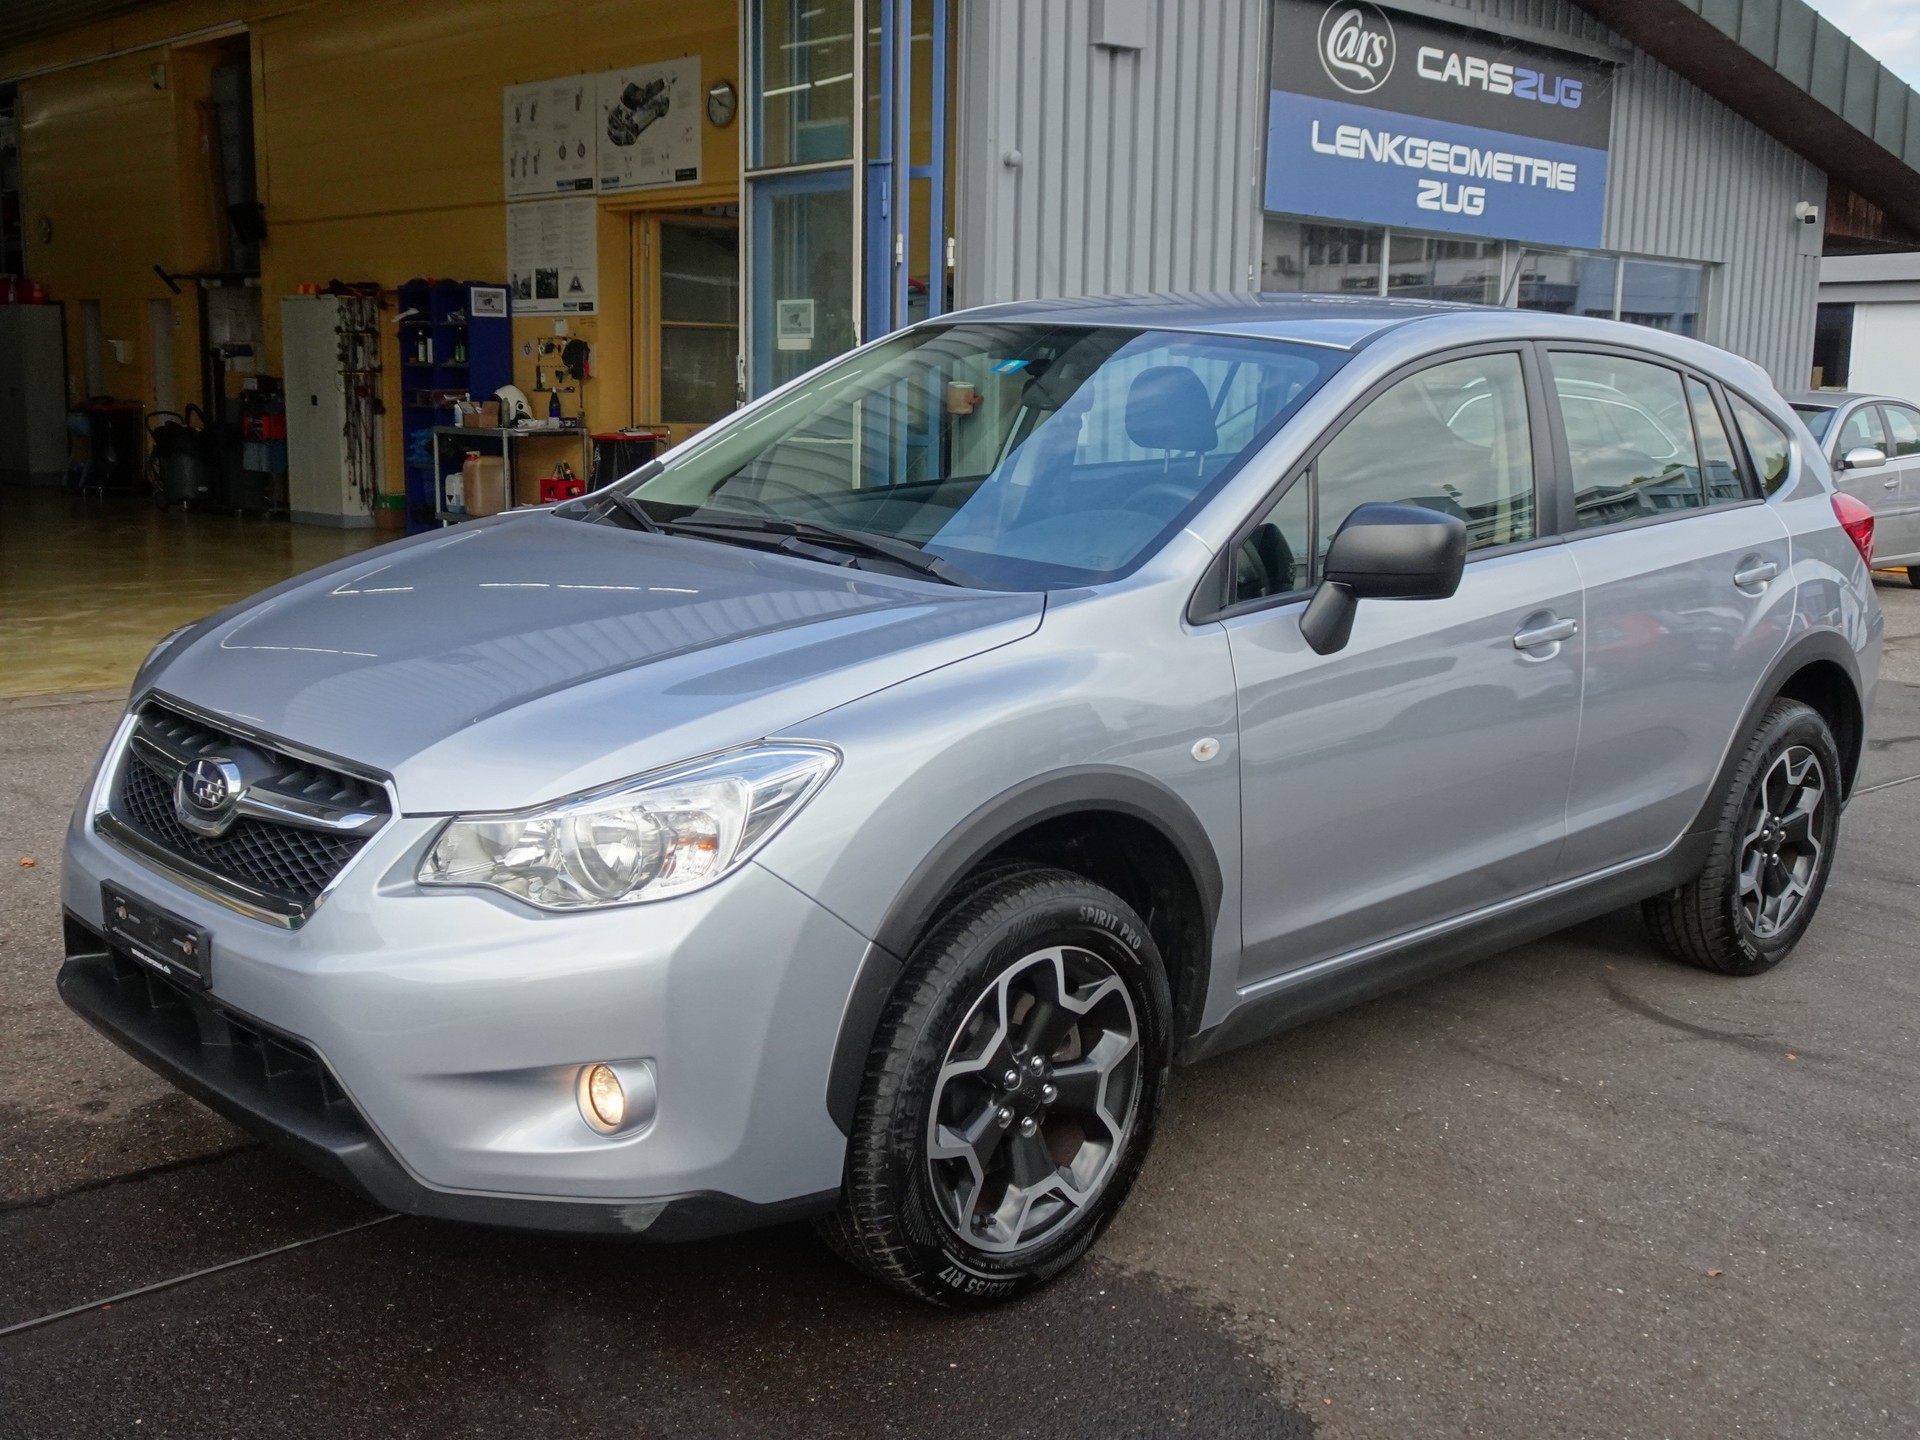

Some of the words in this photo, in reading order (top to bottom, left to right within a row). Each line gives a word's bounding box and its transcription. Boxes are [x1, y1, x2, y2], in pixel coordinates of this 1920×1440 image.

[1327, 9, 1388, 83] Cars
[1311, 120, 1577, 192] LENKGEOMETRIE
[1416, 179, 1486, 216] ZUG
[1079, 906, 1119, 930] SPIRIT
[1120, 923, 1142, 950] PRO
[939, 1265, 966, 1288] R17
